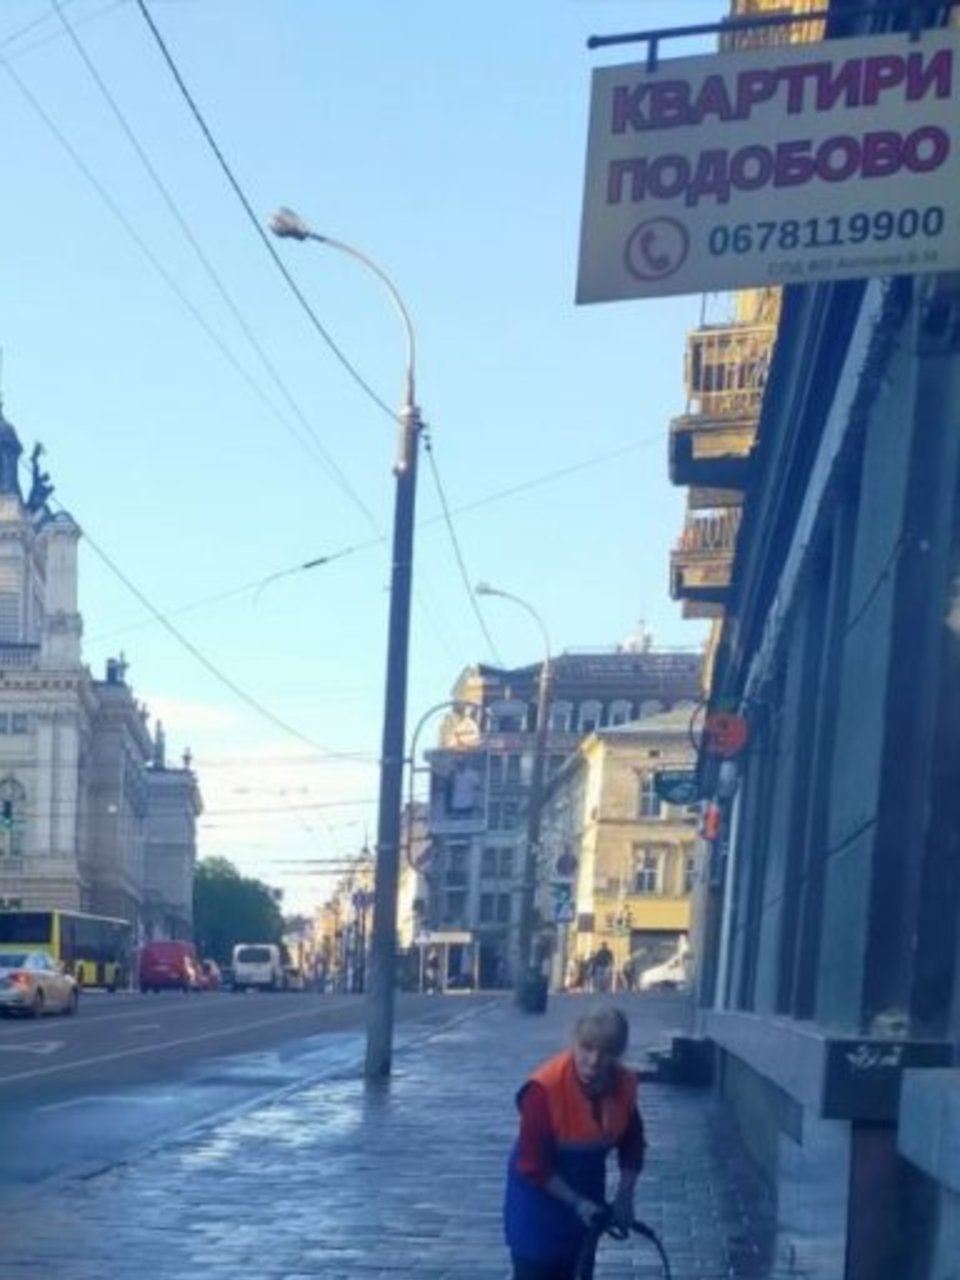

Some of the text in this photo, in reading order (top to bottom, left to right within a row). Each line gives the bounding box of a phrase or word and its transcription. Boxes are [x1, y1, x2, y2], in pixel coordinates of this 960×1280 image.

[612, 50, 953, 134] КВАРТИРИ
[607, 126, 951, 207] ПОДОБОВО
[708, 207, 944, 255] 0678119900
